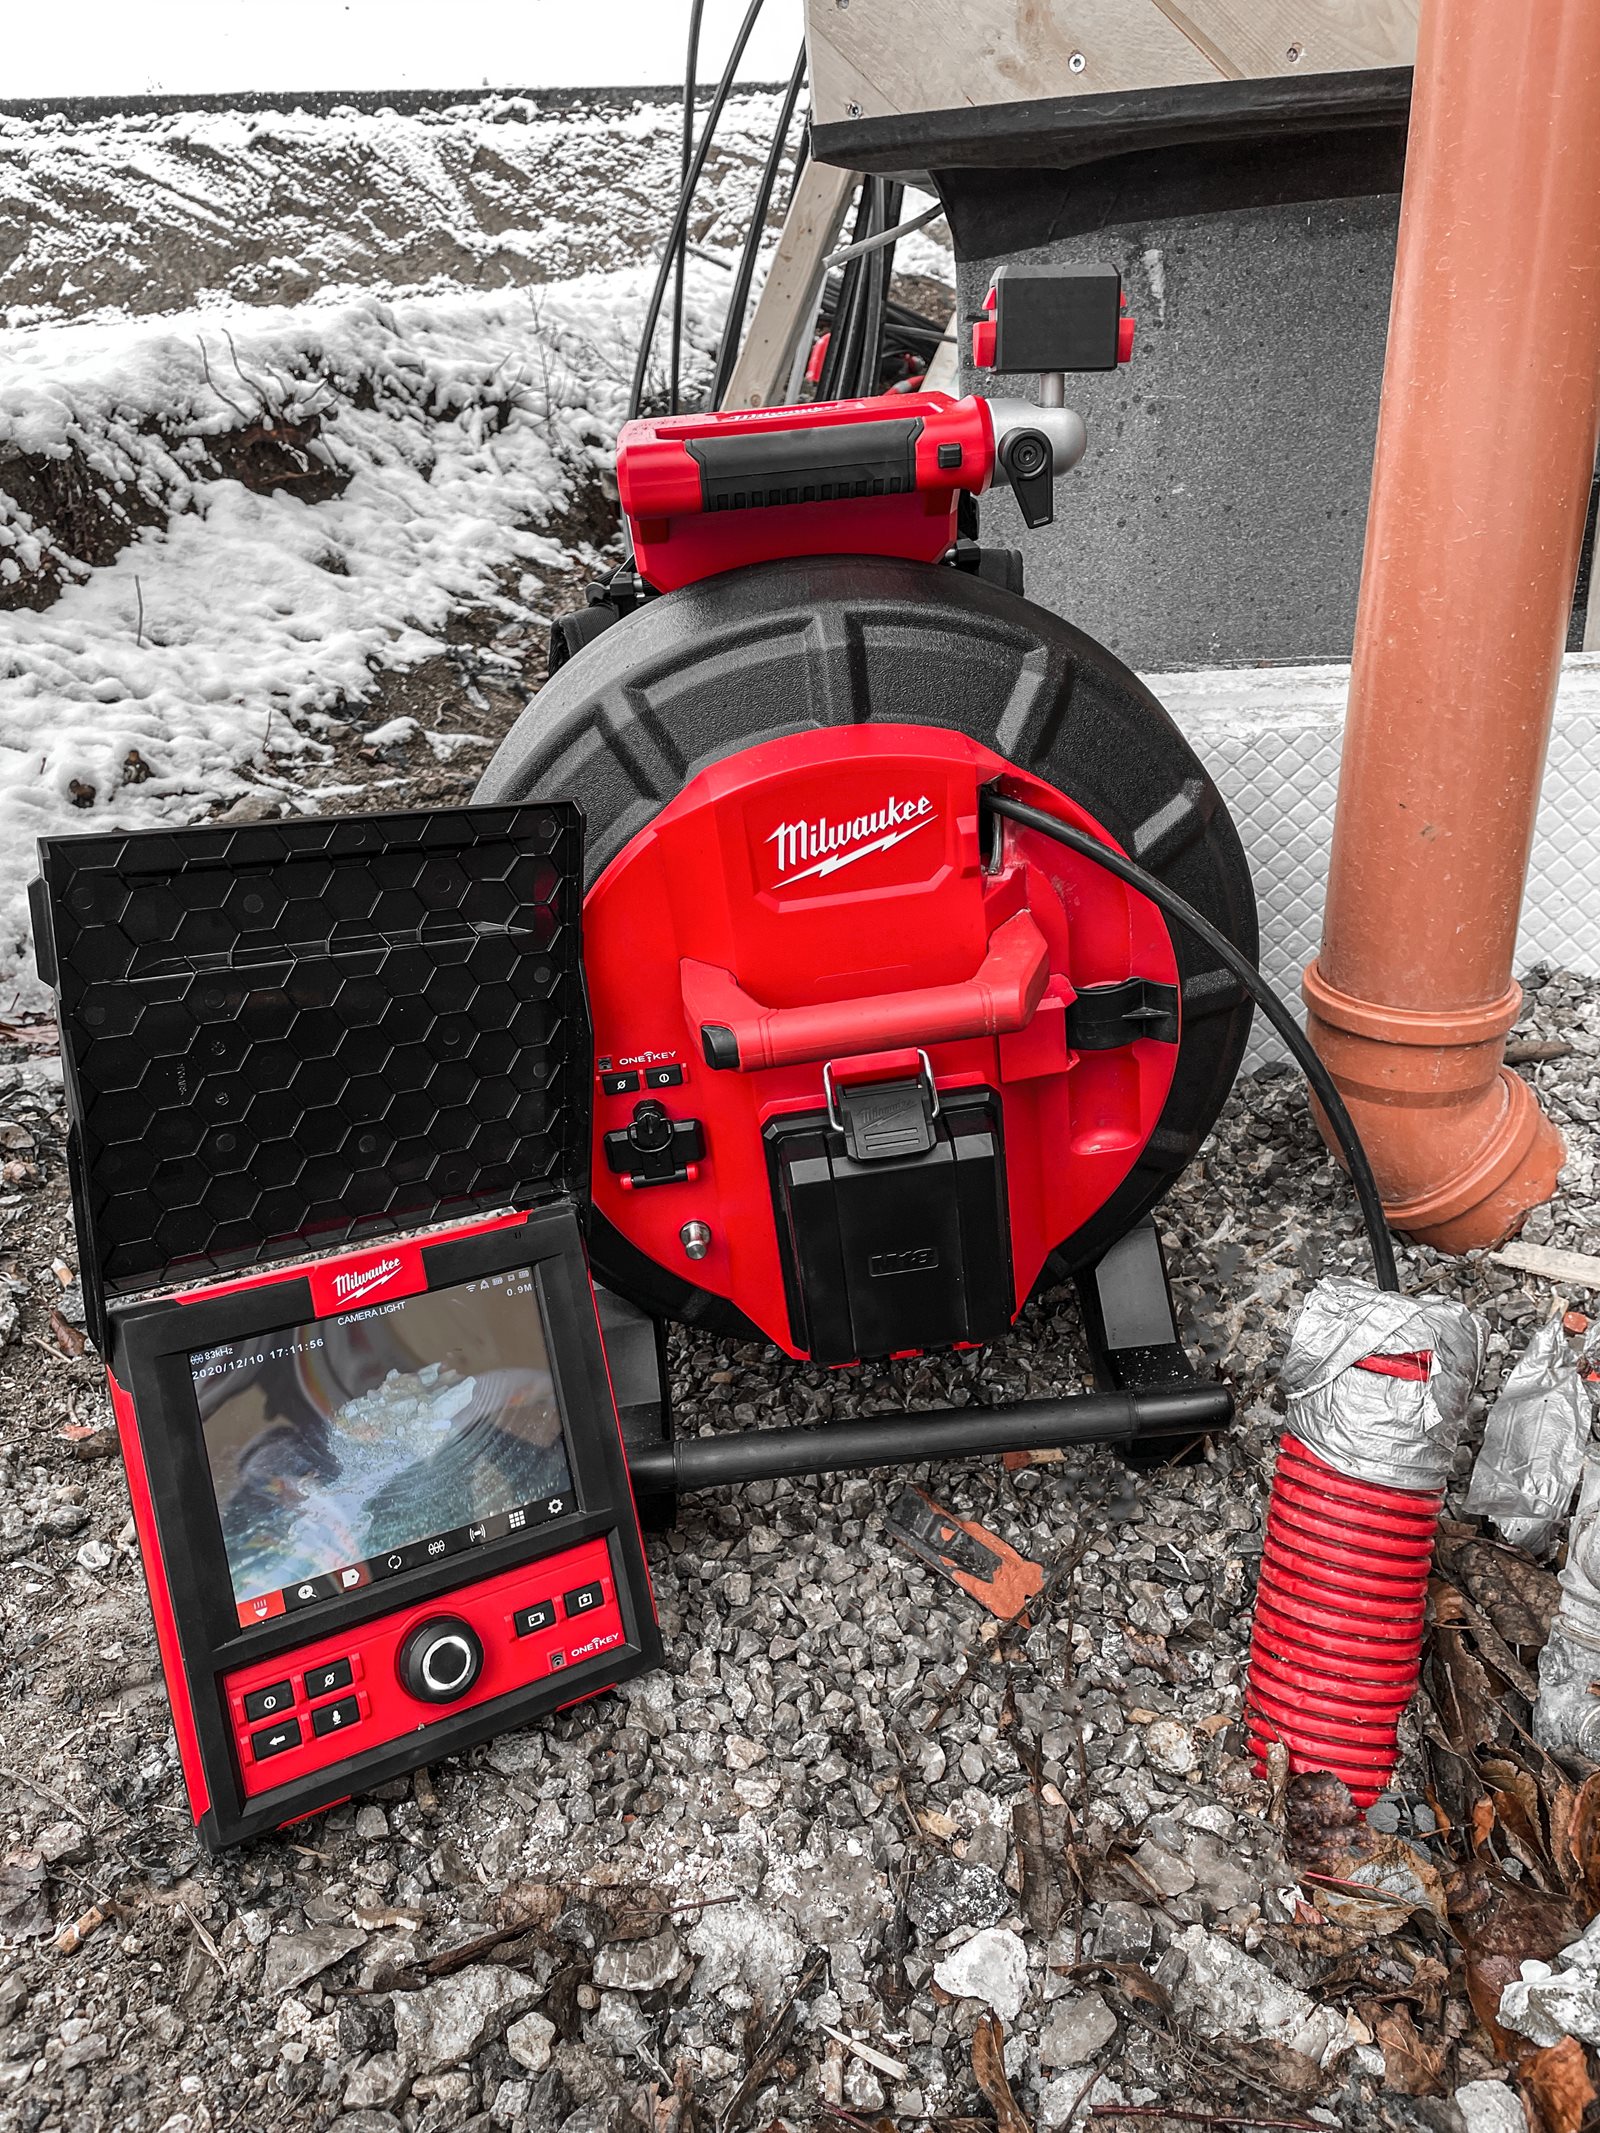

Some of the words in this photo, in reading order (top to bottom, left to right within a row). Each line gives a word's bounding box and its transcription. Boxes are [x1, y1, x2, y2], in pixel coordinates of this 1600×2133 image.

[763, 795, 933, 872] Milwaukee
[331, 1257, 401, 1297] Milwaukee
[506, 1283, 533, 1297] 0.9M
[337, 1308, 379, 1326] CAMERA
[379, 1301, 406, 1316] LIGHT
[191, 1354, 264, 1380] 2020/12/10
[269, 1338, 324, 1360] 17:11:56
[203, 1346, 234, 1361] 83kHz
